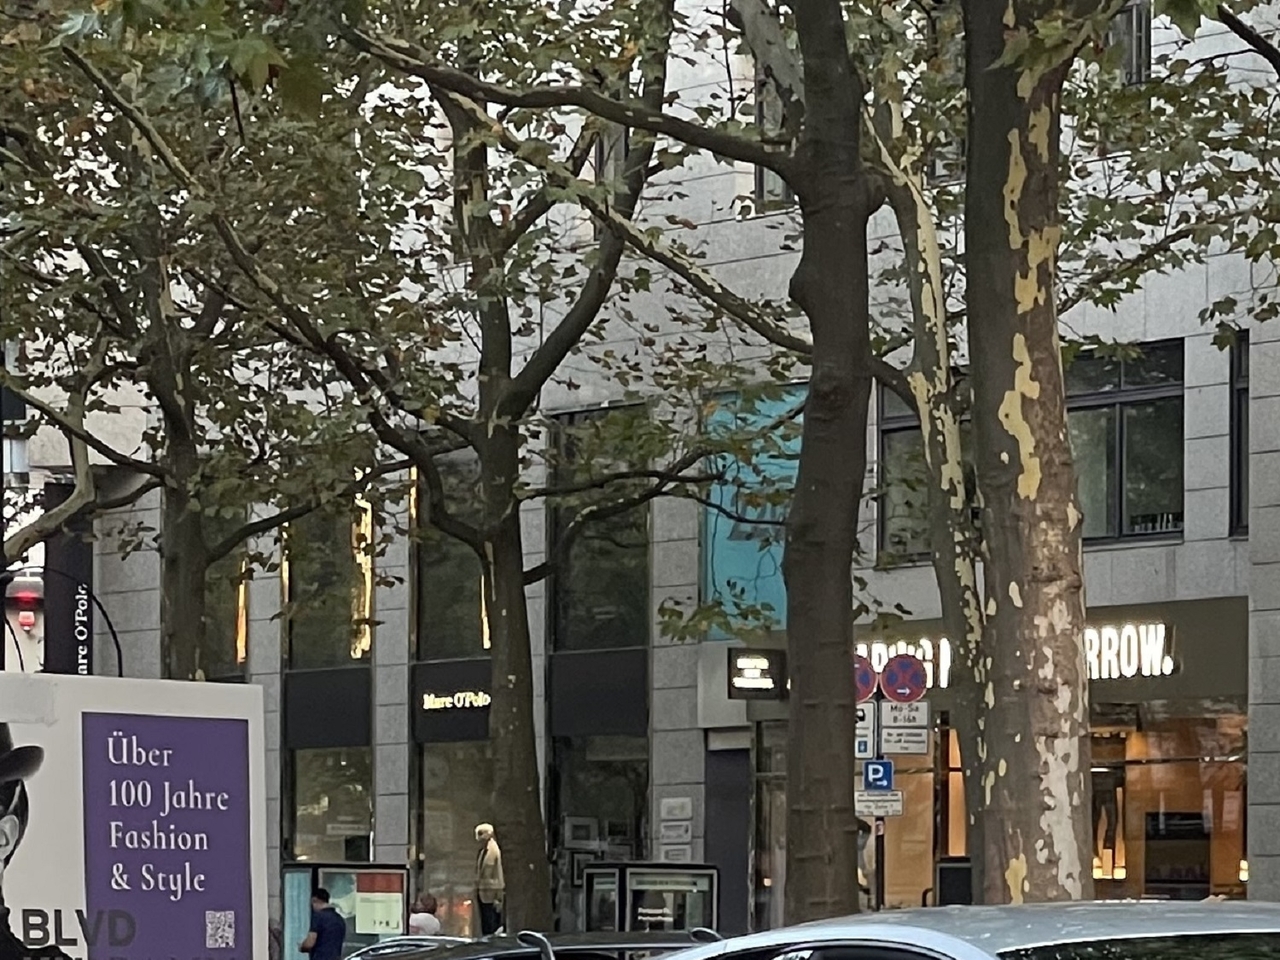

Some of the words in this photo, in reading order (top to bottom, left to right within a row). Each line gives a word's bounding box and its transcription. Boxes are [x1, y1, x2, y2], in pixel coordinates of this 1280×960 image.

[1083, 623, 1174, 680] RROW.
[107, 731, 172, 767] Über
[868, 764, 884, 783] P
[109, 779, 152, 808] 100
[159, 779, 229, 817] Jahre
[109, 820, 208, 850] Fashion
[111, 863, 131, 890] &
[141, 862, 205, 901] Style
[22, 909, 136, 947] BLVD
